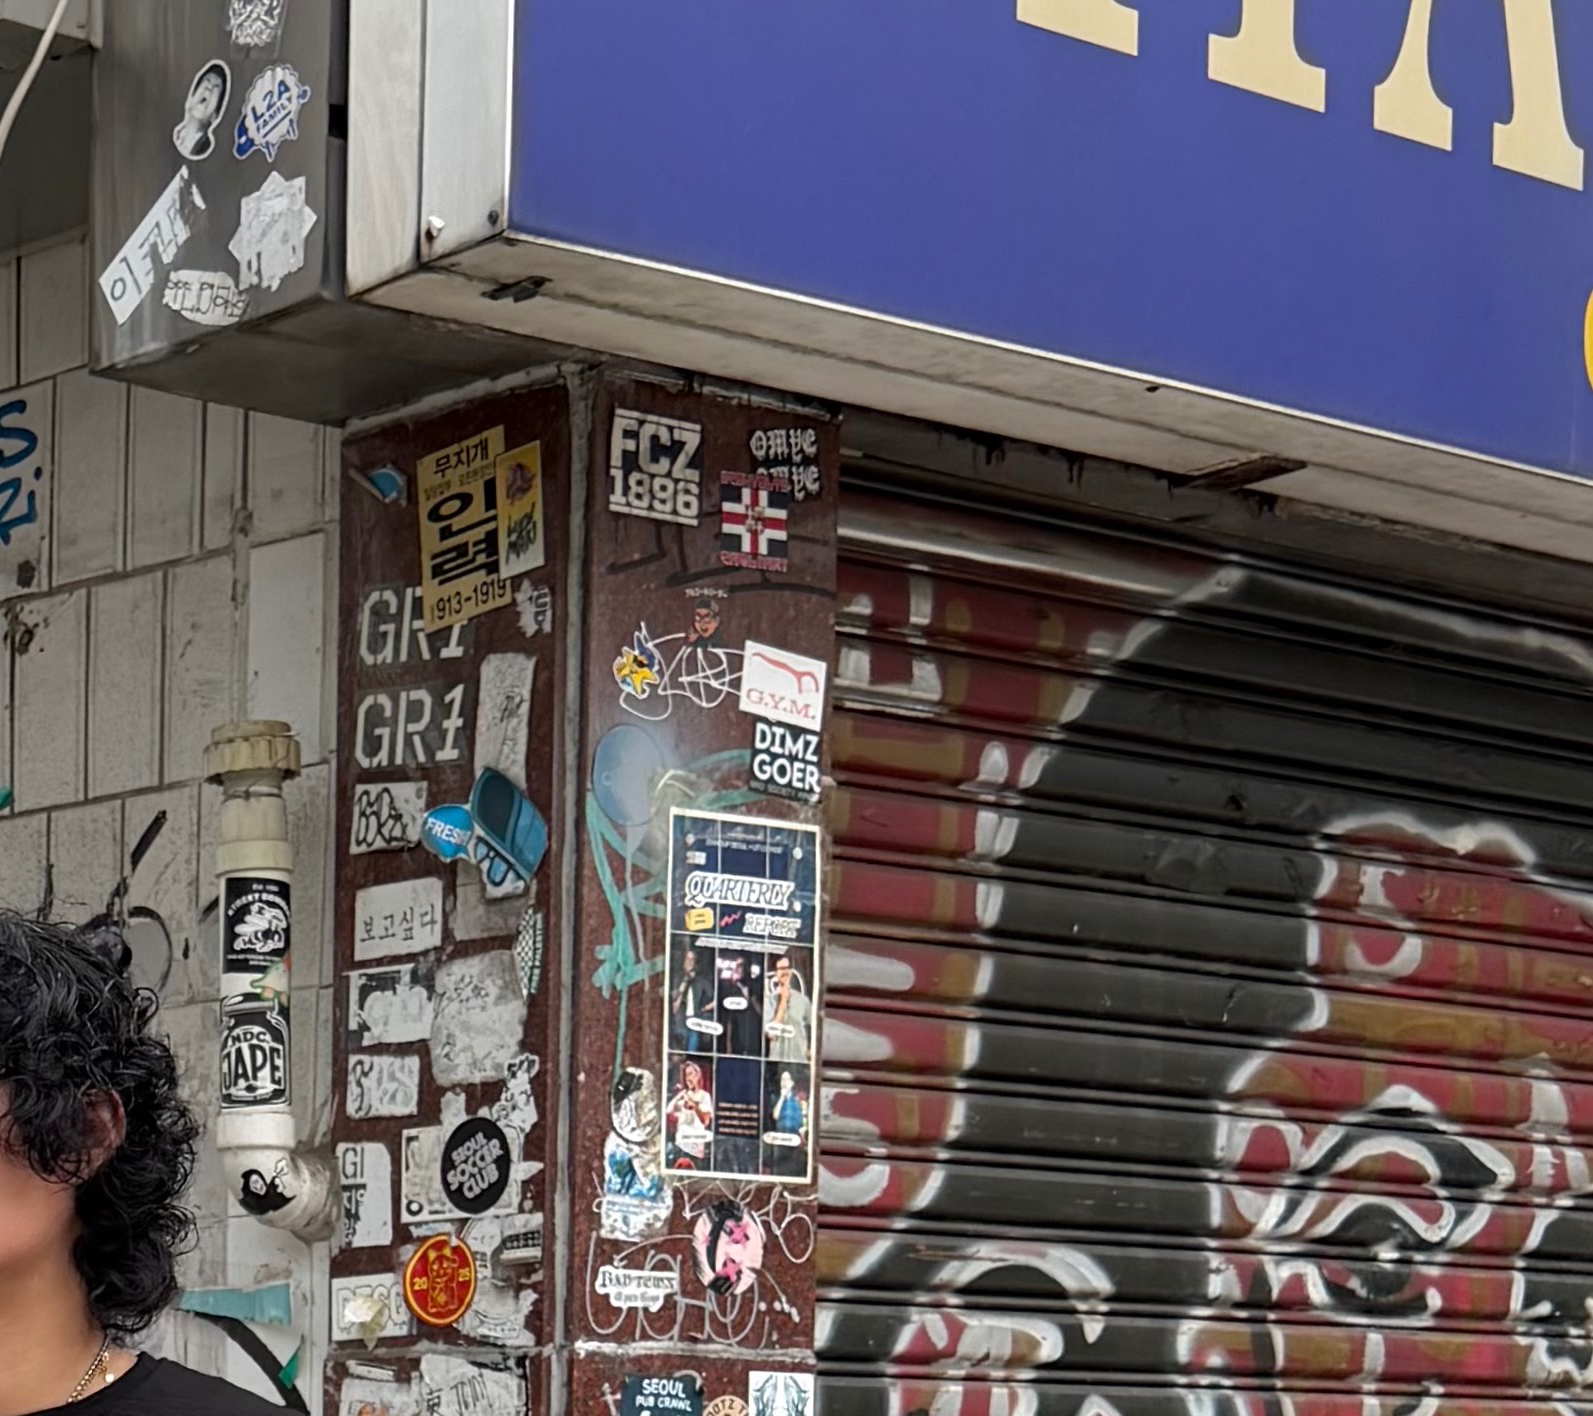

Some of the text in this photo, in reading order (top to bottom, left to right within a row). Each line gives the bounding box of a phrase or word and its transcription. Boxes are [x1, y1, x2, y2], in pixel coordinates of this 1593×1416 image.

[434, 437, 489, 477] 무지개
[610, 416, 701, 482] FCZ
[609, 468, 700, 517] 1896
[746, 688, 815, 720] G.Y.M.
[355, 684, 465, 769] GR1
[755, 722, 819, 762] DIMZ
[753, 753, 821, 793] GOER
[686, 872, 794, 909] QUARTERLY
[359, 903, 438, 943] 보고싶다
[744, 914, 799, 937] REPORT
[446, 1138, 504, 1191] SOCCER
[463, 1163, 499, 1199] CLUB
[413, 1278, 428, 1290] 20
[636, 1395, 692, 1412] PUB CRAWL
[642, 1379, 686, 1398] SEOUL
